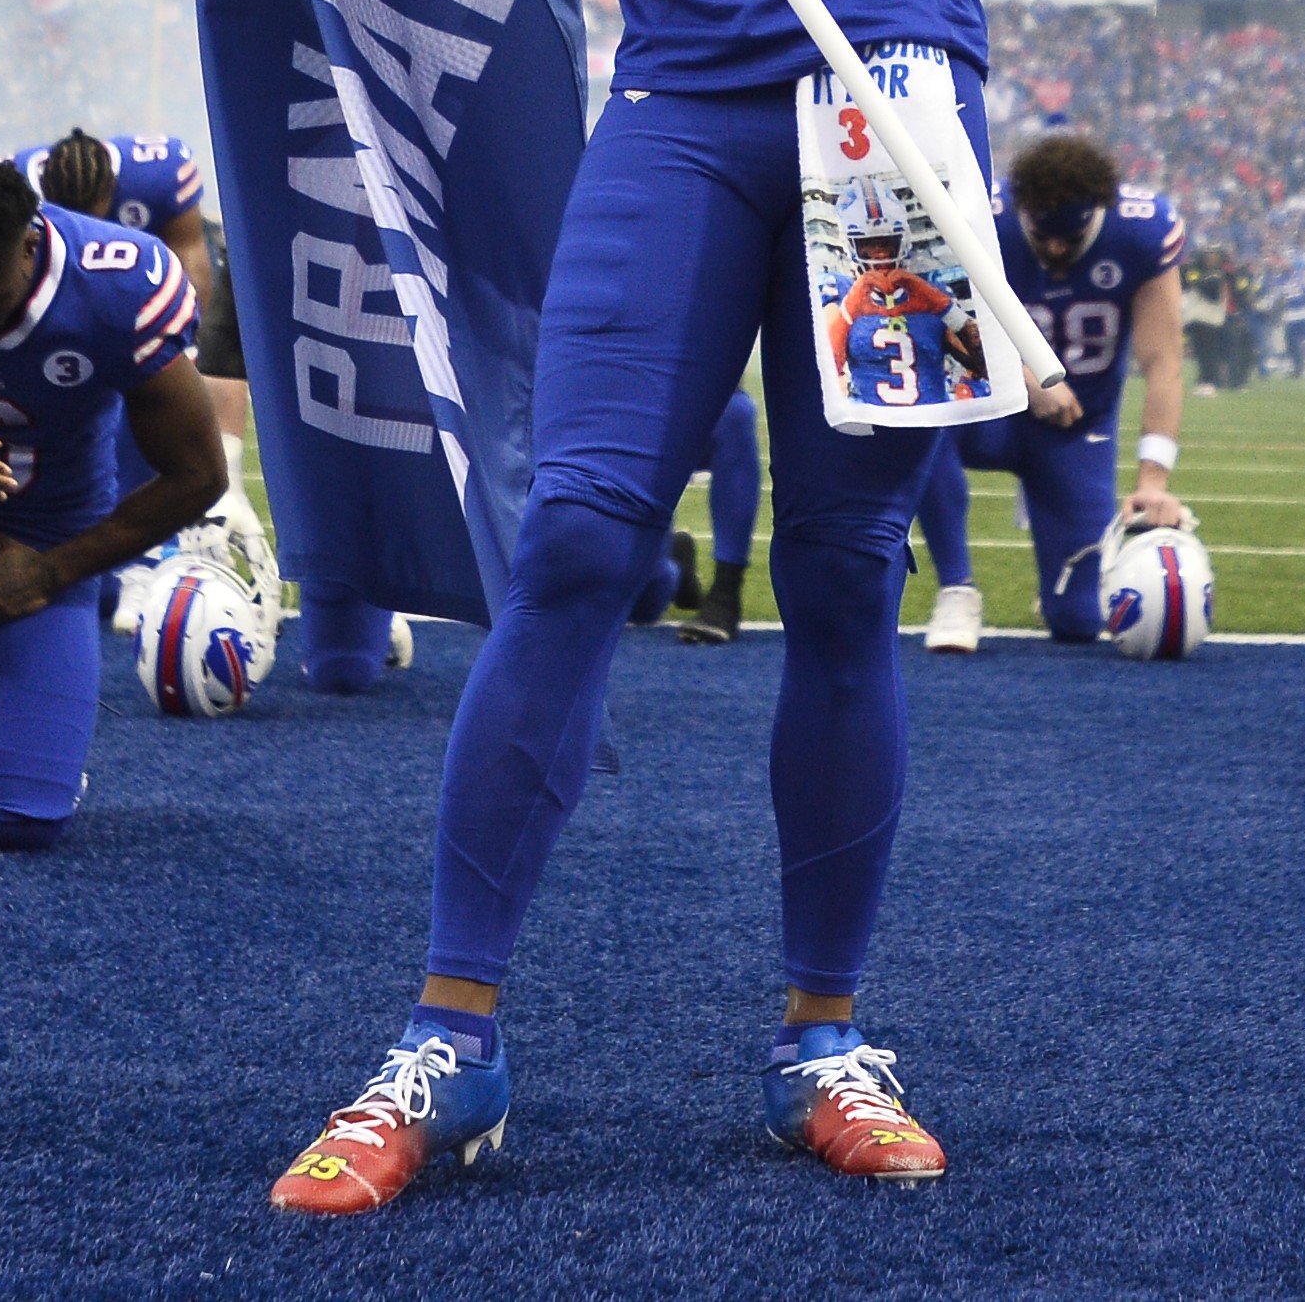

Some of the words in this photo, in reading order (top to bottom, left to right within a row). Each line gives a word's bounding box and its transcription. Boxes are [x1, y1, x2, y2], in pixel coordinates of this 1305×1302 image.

[846, 63, 910, 103] OR
[838, 108, 871, 161] 3
[81, 240, 140, 271] 6
[55, 356, 82, 383] 3
[872, 326, 920, 407] 3
[285, 1152, 349, 1182] 25
